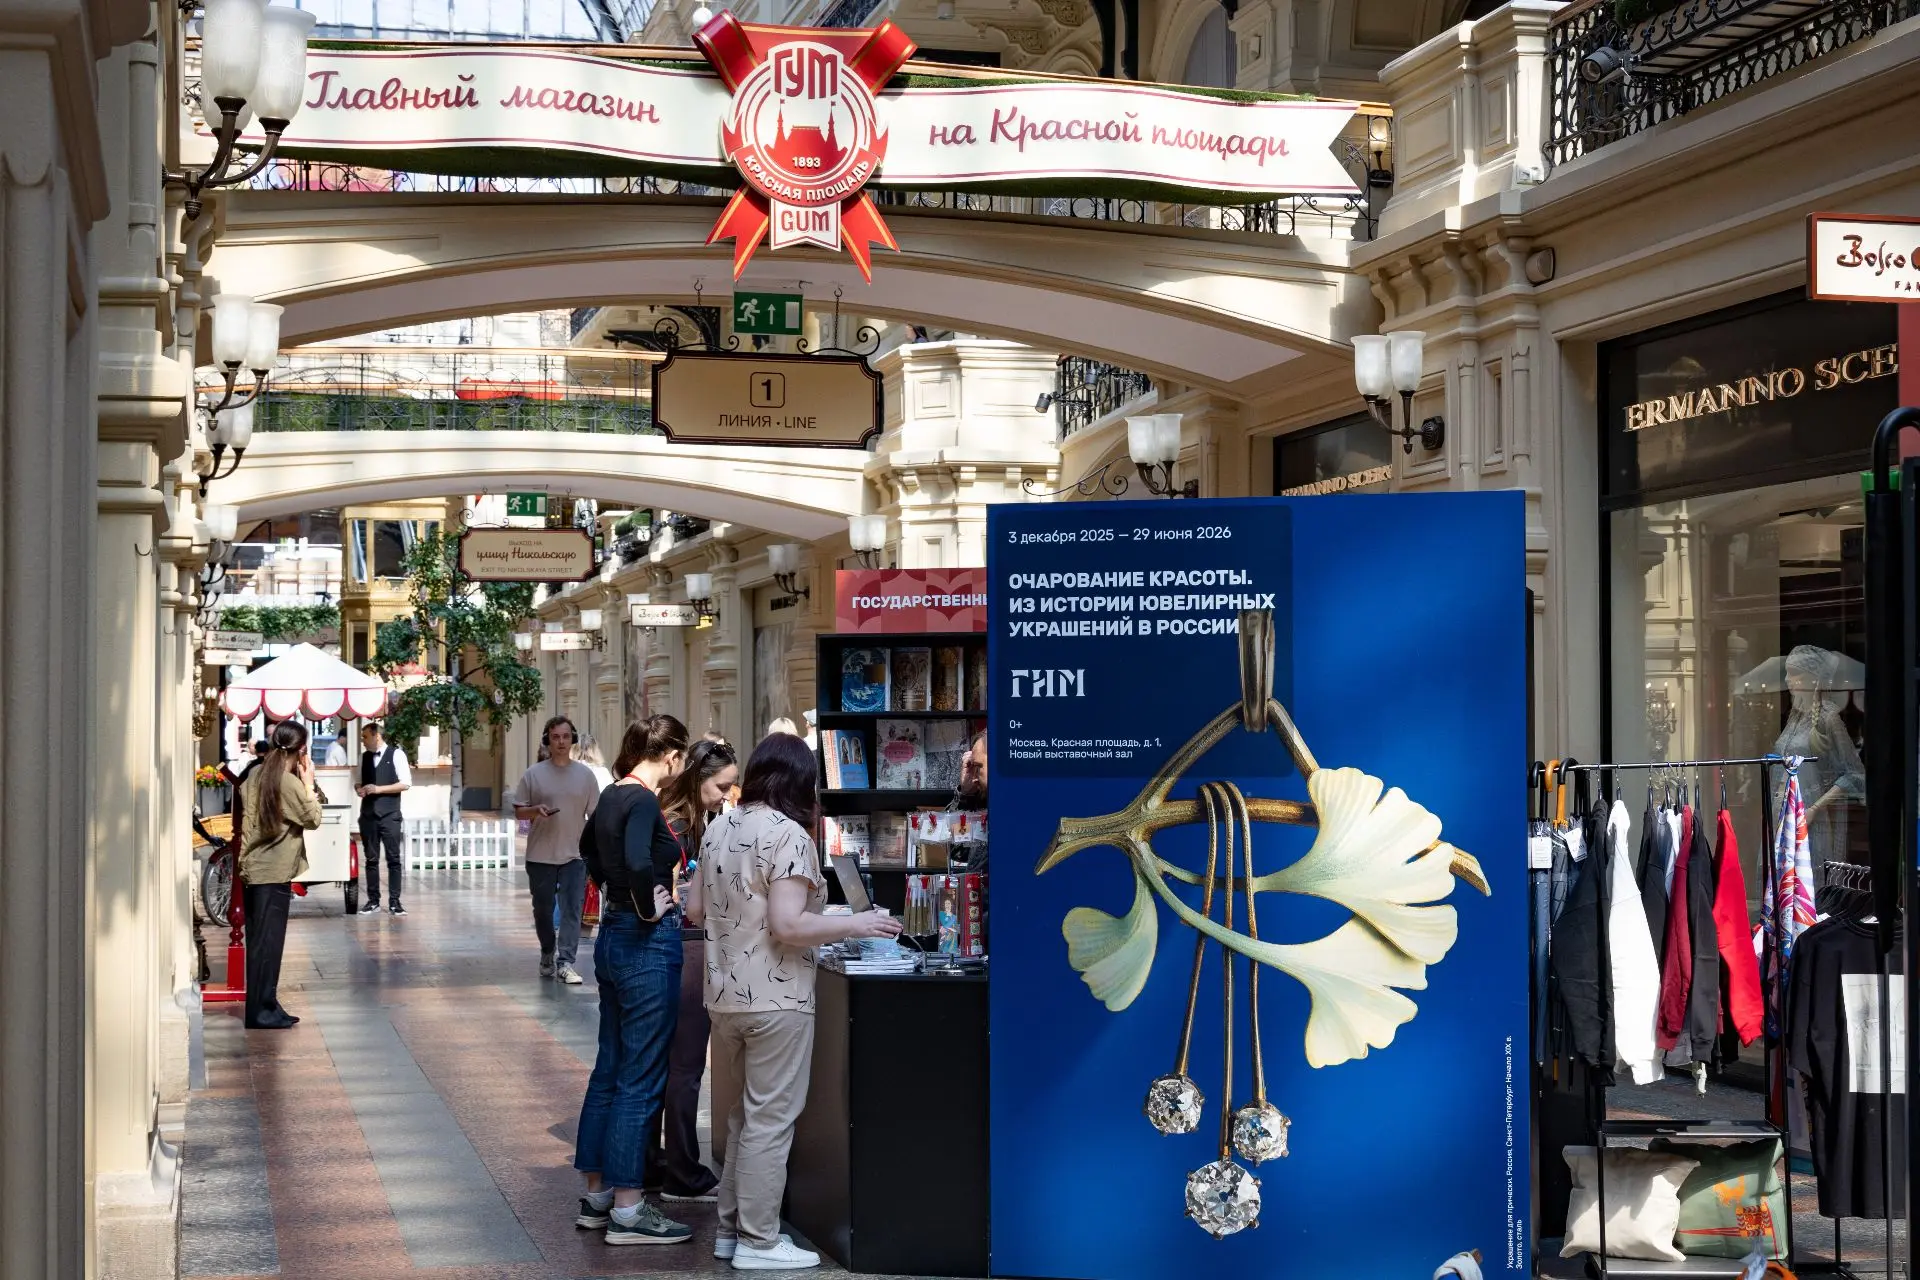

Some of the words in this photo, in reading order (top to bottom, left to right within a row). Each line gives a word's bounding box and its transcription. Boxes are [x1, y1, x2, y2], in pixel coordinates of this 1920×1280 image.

[774, 47, 838, 100] ГУМ
[306, 71, 479, 110] Главный
[500, 86, 659, 123] магазин
[929, 125, 976, 145] на
[990, 106, 1142, 152] Красной
[1152, 128, 1289, 166] площади
[792, 157, 821, 168] 1893
[744, 155, 802, 201] КРАСНАЯ
[806, 160, 869, 201] ПЛОЩАДЬ
[780, 210, 830, 232] GUM
[761, 378, 772, 401] 1
[1623, 368, 1805, 432] ERMANNO
[718, 414, 772, 428] ЛИНИЯ
[784, 416, 817, 429] LINE
[1008, 531, 1017, 544] 3
[1020, 529, 1076, 545] декабря
[1080, 528, 1115, 542] 2025
[1133, 528, 1151, 541] 29
[1154, 529, 1193, 540] июня
[1196, 526, 1232, 539] 2026
[477, 550, 509, 563] улицу
[512, 546, 577, 563] Никольскую
[1008, 571, 1145, 590] ОЧАРОВАНИЕ
[1149, 569, 1253, 587] КРАСОТЫ.
[1009, 597, 1036, 614] ИЗ
[1040, 595, 1134, 613] ИСТОРИИ
[1139, 593, 1276, 611] ЮВЕЛИРНЫХ
[1008, 615, 1133, 637] УКРАШЕНИЙ
[1138, 619, 1152, 636] В
[1156, 618, 1239, 635] РОССИИ
[1011, 669, 1085, 697] ГИМ
[1009, 719, 1023, 729] 0+
[1009, 738, 1049, 748] Москва,
[1051, 737, 1093, 749] Красная
[1095, 739, 1141, 749] площадь,
[1009, 749, 1042, 759] Новый
[1044, 748, 1113, 759] выставочный
[1115, 751, 1133, 759] зал
[1506, 1228, 1514, 1270] Украшение
